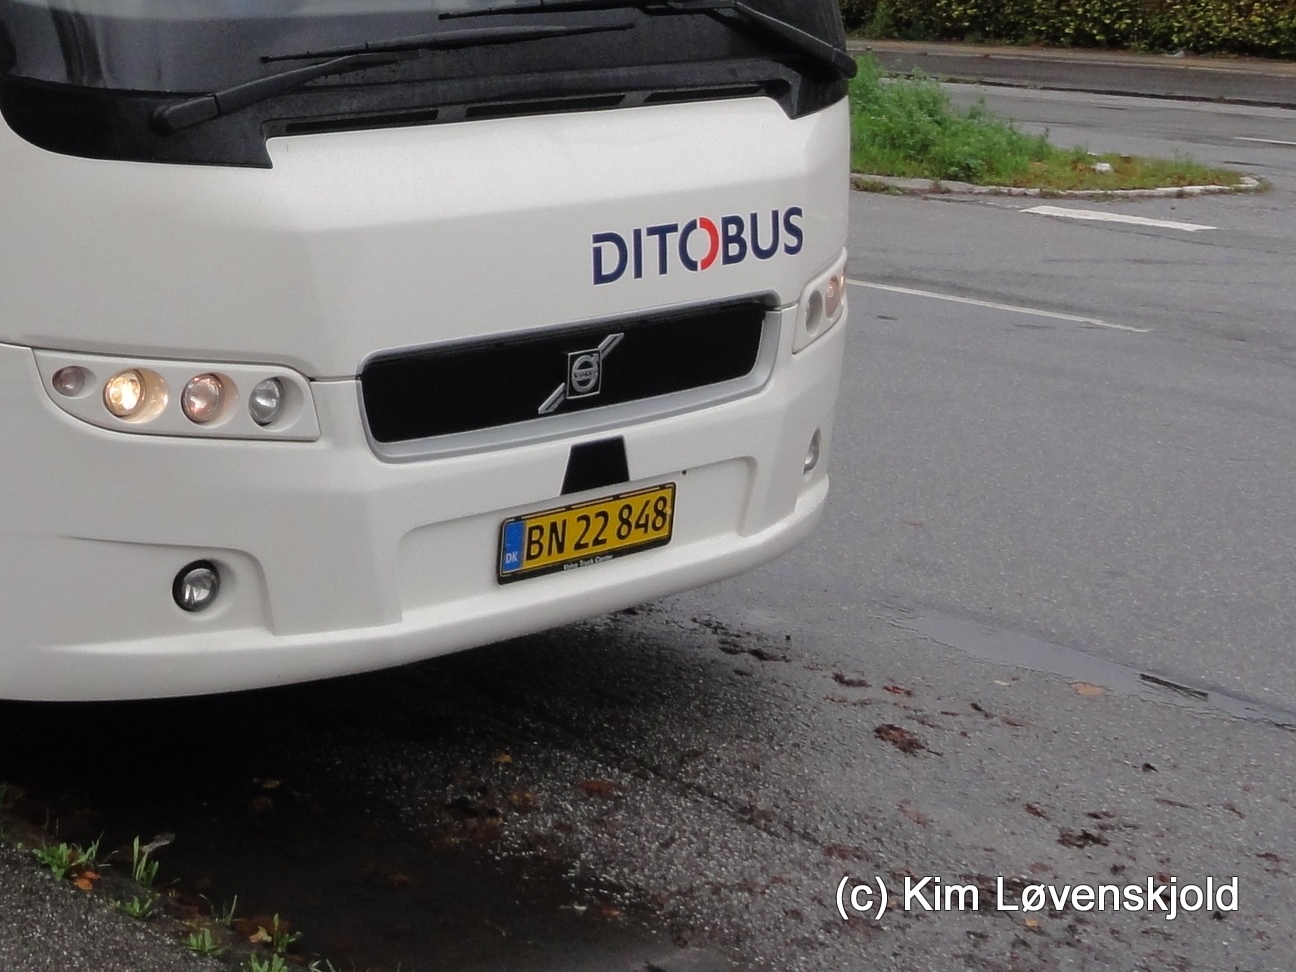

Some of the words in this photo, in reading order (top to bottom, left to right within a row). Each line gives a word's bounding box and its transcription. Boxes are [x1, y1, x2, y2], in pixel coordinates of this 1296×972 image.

[591, 205, 804, 286] DITOBUS
[505, 551, 518, 564] DK
[525, 518, 567, 561] BN
[573, 510, 610, 552] 22
[616, 495, 668, 541] 848
